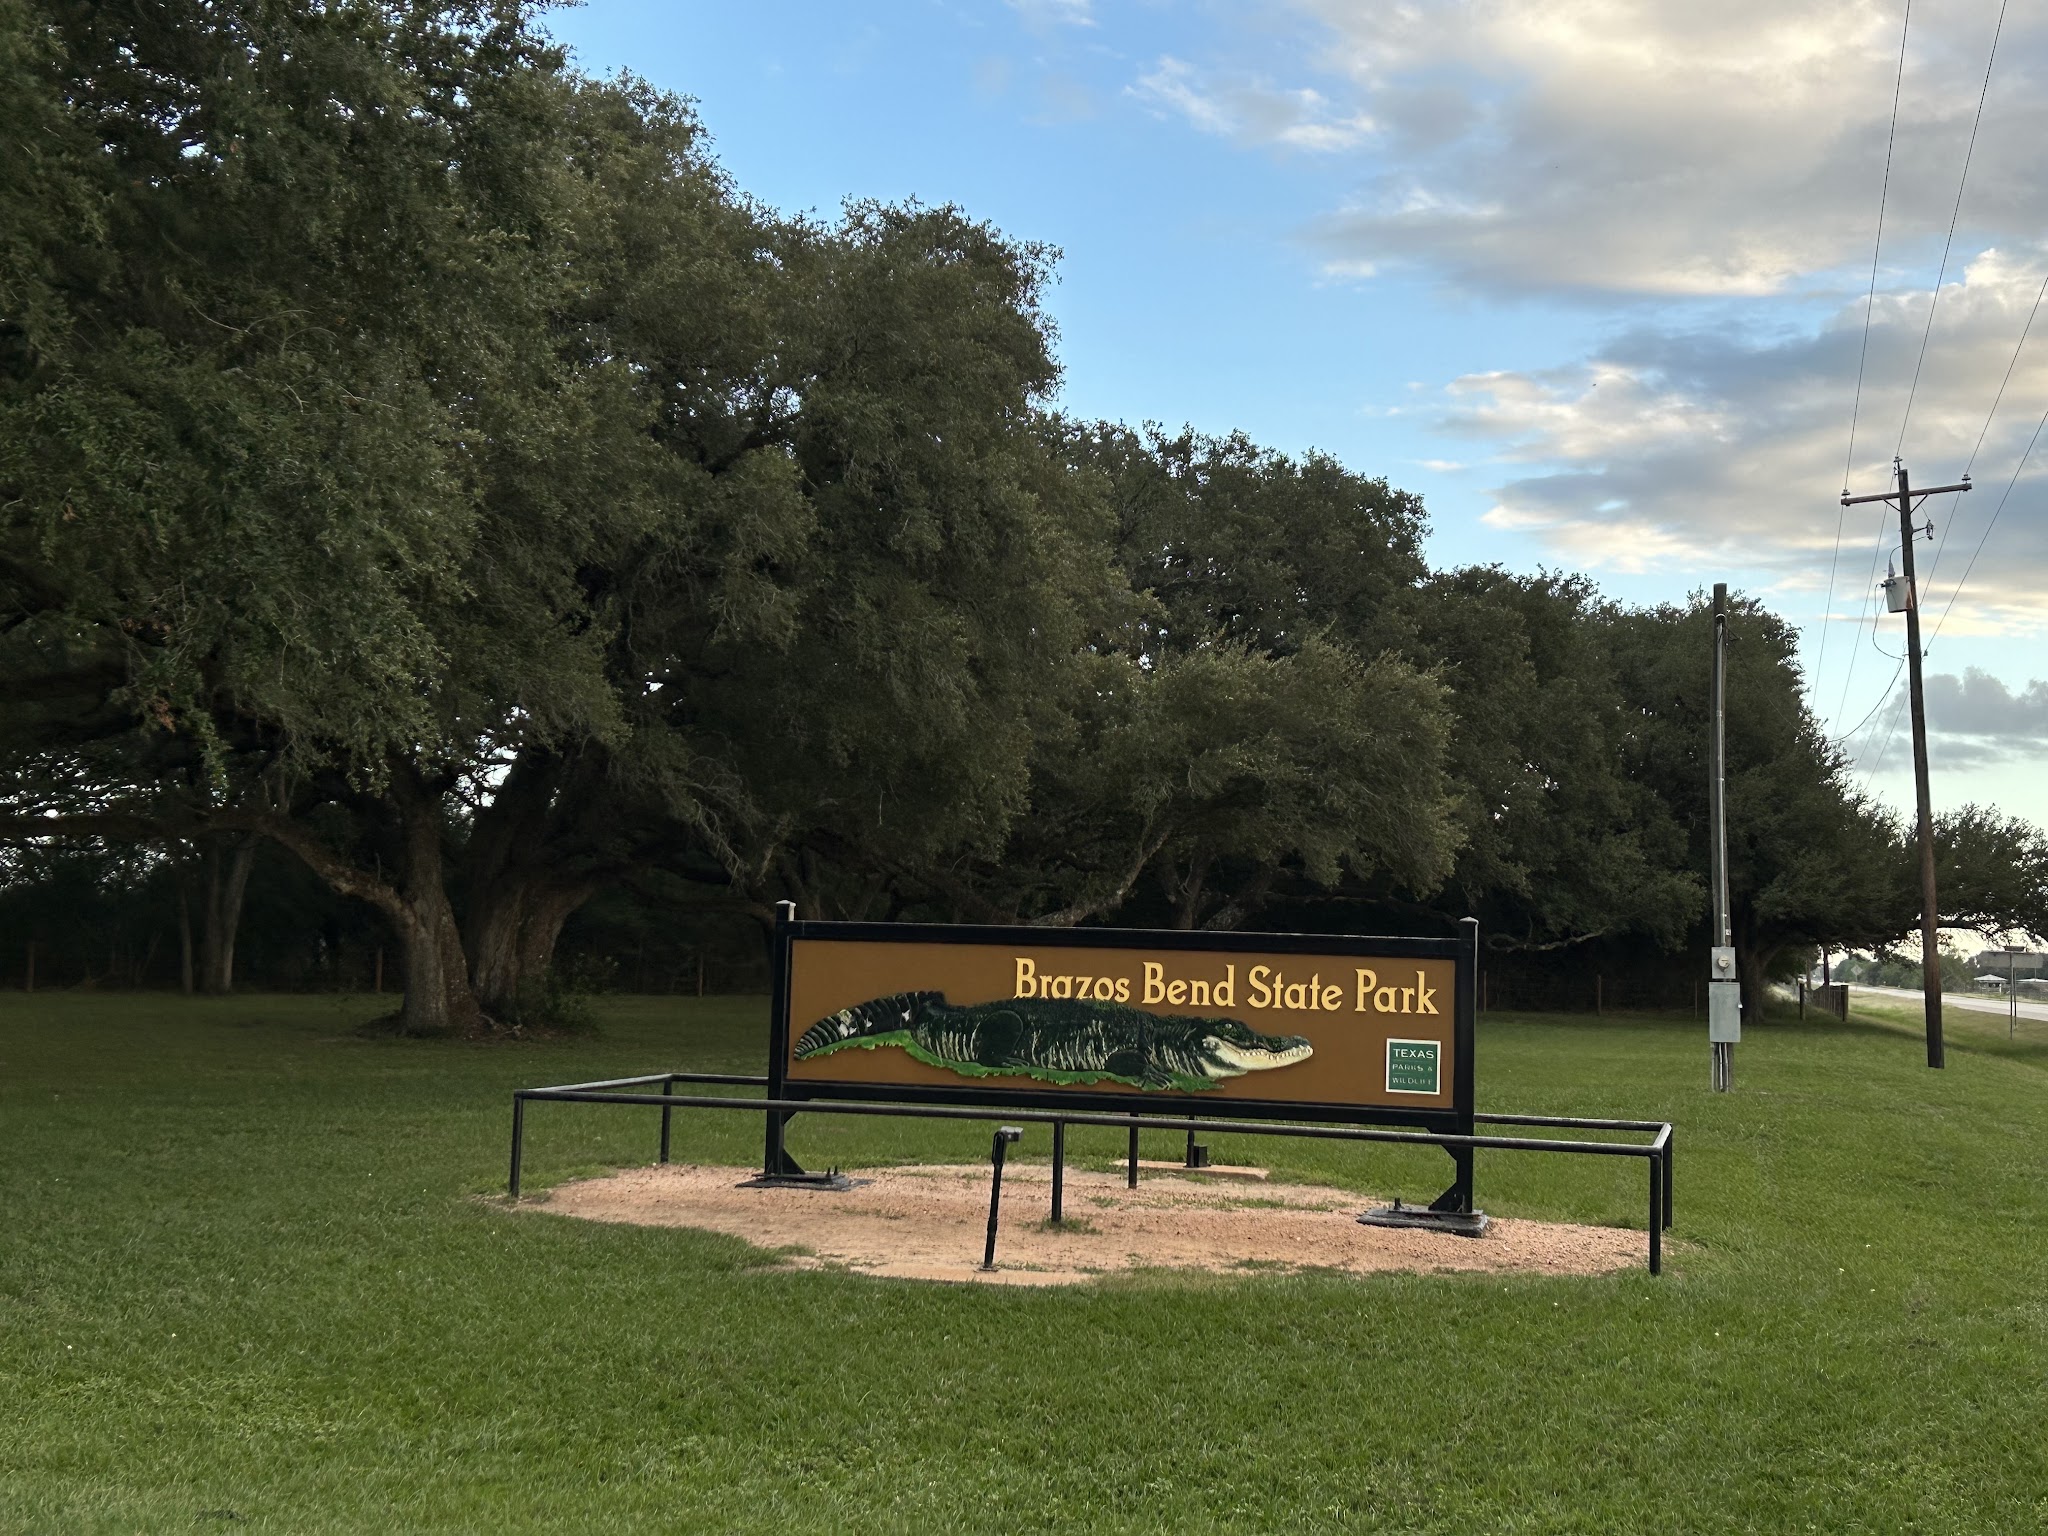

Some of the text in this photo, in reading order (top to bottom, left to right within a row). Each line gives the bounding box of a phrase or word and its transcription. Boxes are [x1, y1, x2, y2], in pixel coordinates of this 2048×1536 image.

[1014, 957, 1440, 1015] Brazos Bend State Park
[1393, 1048, 1435, 1059] TEXAS
[1391, 1063, 1424, 1072] PARKS
